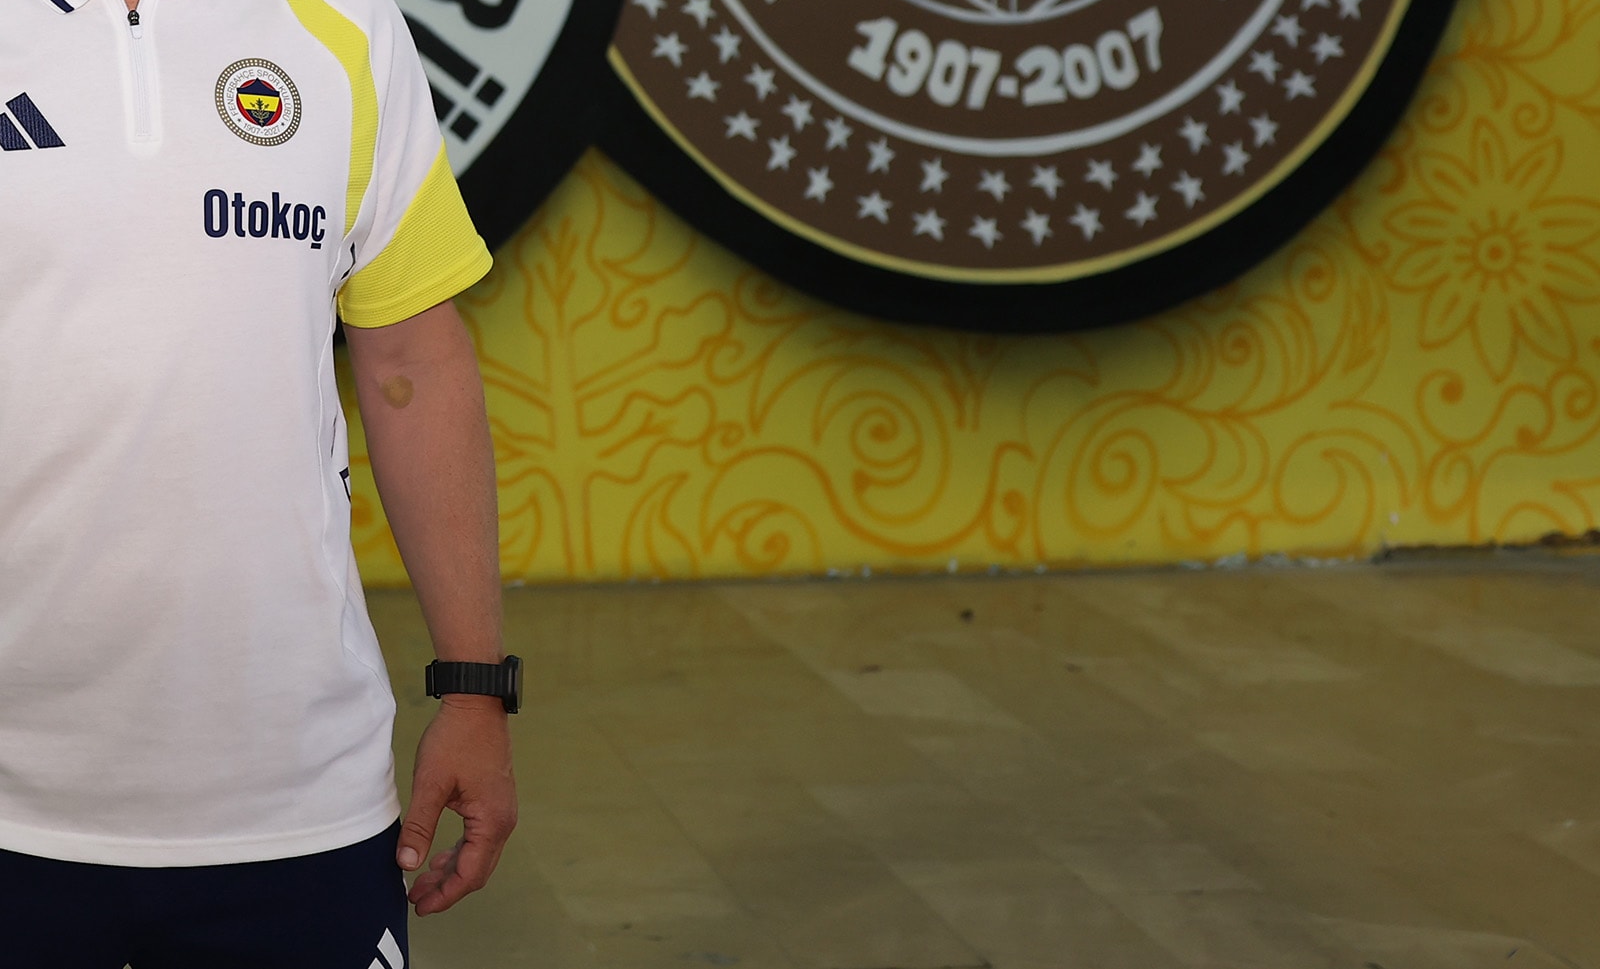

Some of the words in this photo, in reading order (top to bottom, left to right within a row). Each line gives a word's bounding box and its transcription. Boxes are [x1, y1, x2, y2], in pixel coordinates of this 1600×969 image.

[846, 5, 1165, 111] 1907-2007
[226, 69, 255, 117] FENERBAHÇE
[256, 69, 281, 86] SPOR
[203, 188, 327, 250] Otokoç
